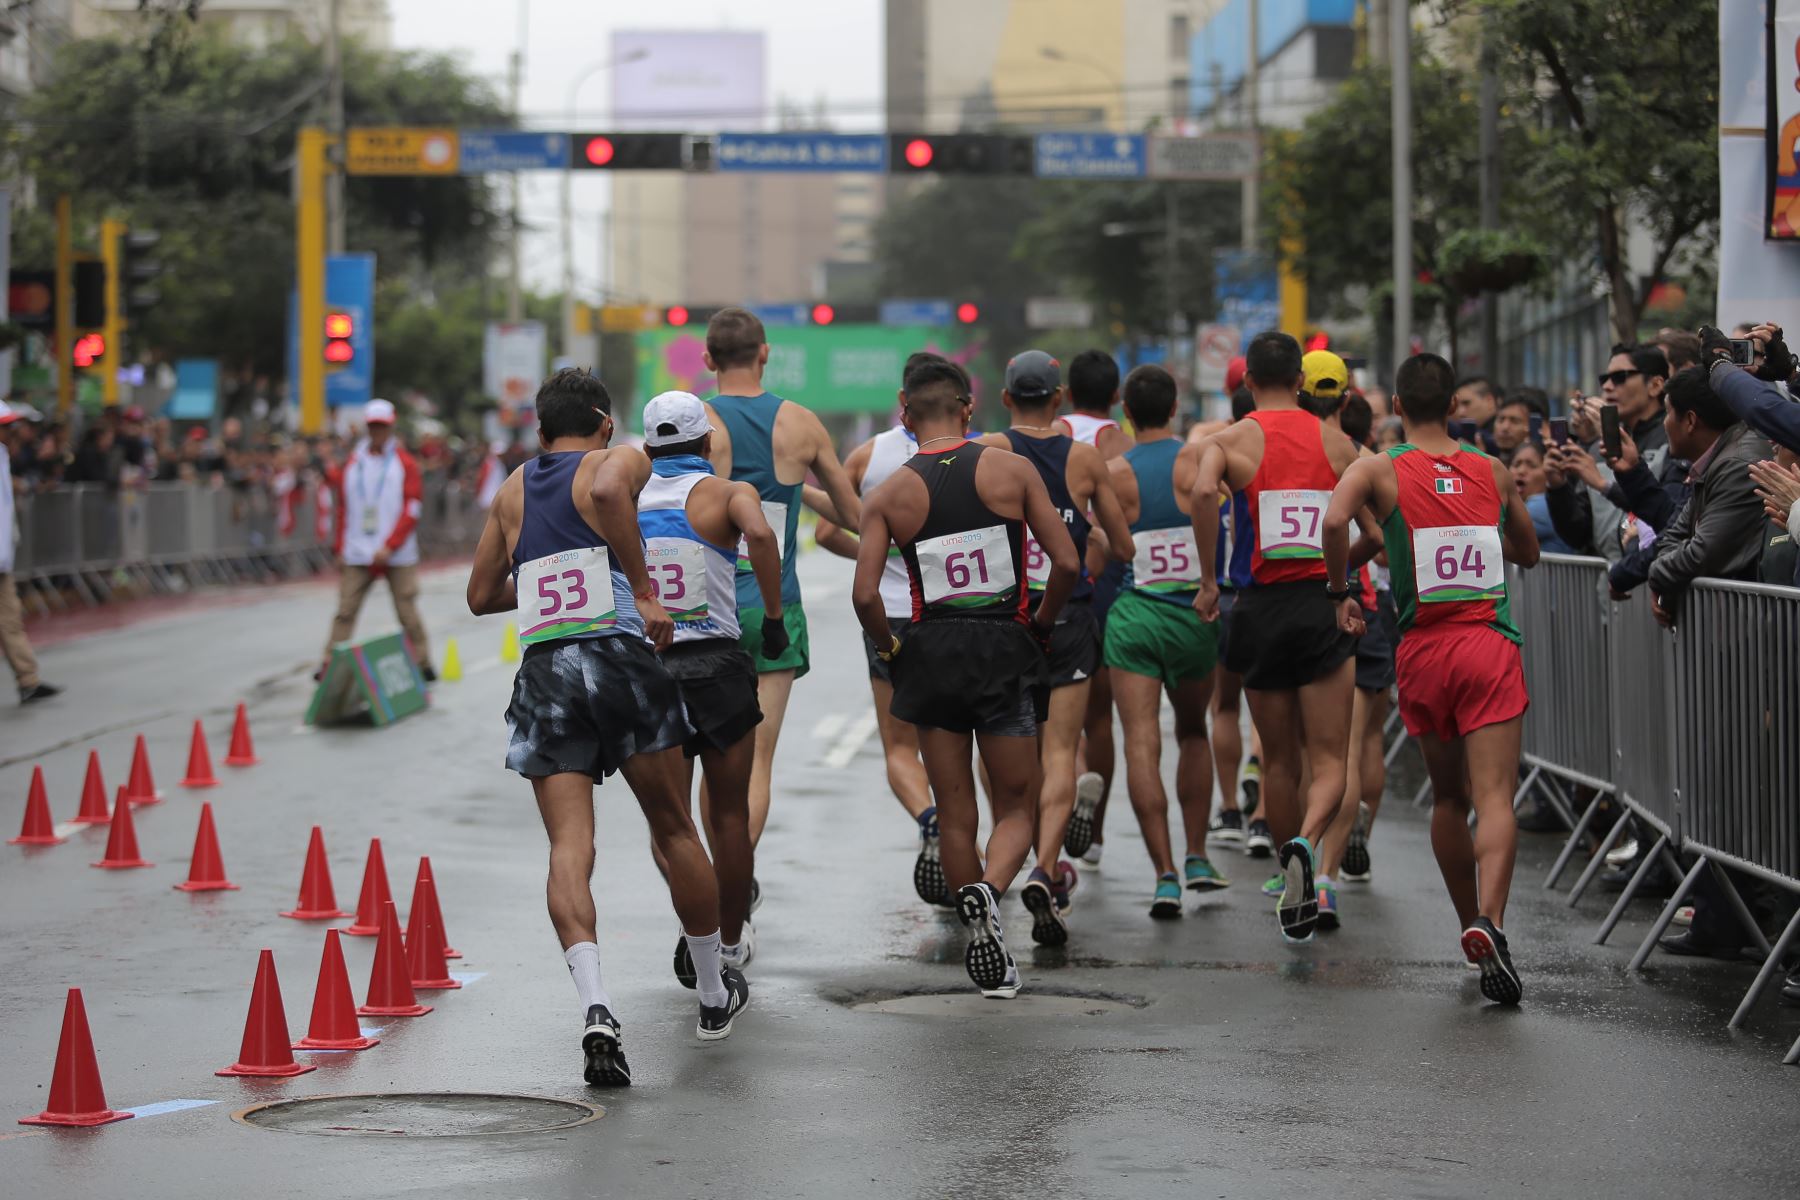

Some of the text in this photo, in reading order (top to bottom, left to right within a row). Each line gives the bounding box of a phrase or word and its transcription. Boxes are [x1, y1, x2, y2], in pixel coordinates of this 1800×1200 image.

[1280, 506, 1320, 538] 57
[945, 548, 989, 589] 61
[1150, 543, 1189, 574] 55
[1435, 544, 1486, 580] 64
[537, 568, 589, 617] 53
